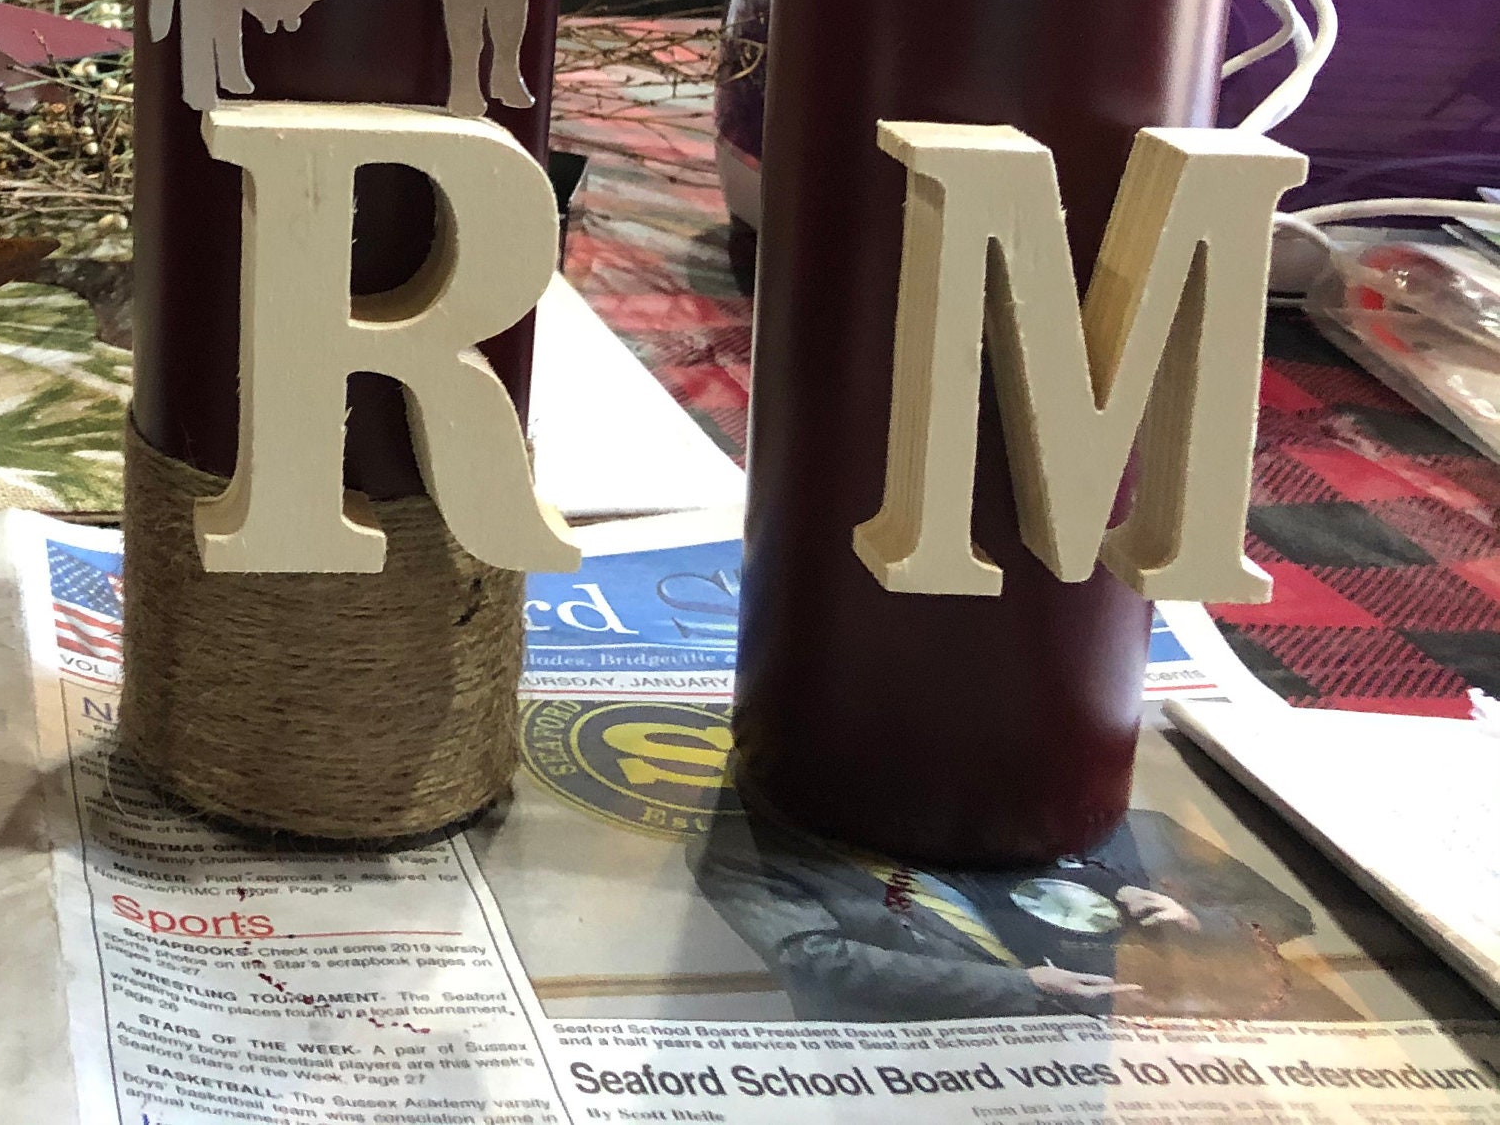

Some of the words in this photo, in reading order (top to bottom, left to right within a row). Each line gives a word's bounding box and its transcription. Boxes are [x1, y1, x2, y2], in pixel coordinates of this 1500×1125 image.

[194, 101, 580, 573] R
[853, 121, 1308, 604] M
[528, 653, 591, 668] lades,
[600, 652, 717, 668] Bridgeville
[523, 676, 625, 689] URSDAY,
[630, 676, 729, 688] JANUARY
[108, 831, 205, 853] CHRISTMAS
[146, 853, 195, 866] Family
[289, 885, 329, 895] Page
[333, 885, 353, 893] 20
[111, 894, 275, 936] Sports
[258, 946, 309, 956] Check
[342, 944, 388, 954] some
[391, 943, 432, 953] 2019
[435, 944, 487, 956] varsity
[327, 956, 411, 970] scrapbook
[416, 957, 466, 968] pages
[131, 967, 238, 1002] WRESTLING
[401, 991, 431, 1002] The
[442, 991, 508, 1002] Seaford
[183, 995, 224, 1012] team
[227, 1004, 282, 1018] places
[138, 1013, 202, 1040] STARS
[212, 1033, 237, 1045] OF
[249, 1039, 287, 1052] THE
[395, 1044, 427, 1058] pair
[465, 1041, 528, 1053] Sussex
[553, 1023, 624, 1035] Seaford
[628, 1024, 692, 1037] School
[694, 1025, 750, 1038] Board
[754, 1026, 840, 1038] President
[845, 1027, 896, 1038] David
[938, 1023, 1017, 1037] presents
[117, 1021, 194, 1052] Academy
[247, 1051, 334, 1069] basketball
[339, 1059, 401, 1072] players
[407, 1059, 435, 1070] are
[439, 1057, 471, 1069] this
[559, 1035, 593, 1047] and
[653, 1038, 703, 1050] years
[707, 1038, 726, 1049] of
[731, 1039, 798, 1050] service
[801, 1040, 821, 1051] to
[825, 1039, 855, 1050] the
[859, 1039, 932, 1051] Seaford
[934, 1036, 1000, 1049] School
[117, 1034, 183, 1061] Seaford
[189, 1053, 234, 1072] Stars
[261, 1066, 288, 1078] the
[353, 1073, 400, 1087] Page
[569, 1061, 728, 1096] Seaford
[730, 1064, 876, 1097] School
[876, 1061, 1006, 1096] Board
[1006, 1059, 1123, 1088] votes
[1120, 1057, 1171, 1086] to
[1167, 1057, 1268, 1086] hold
[1267, 1059, 1493, 1090] referendum
[176, 1085, 265, 1111] basketball
[293, 1090, 326, 1105] The
[332, 1094, 398, 1108] Sussex
[405, 1097, 487, 1111] Academy
[493, 1098, 551, 1110] varsity
[618, 1108, 668, 1122] Scott
